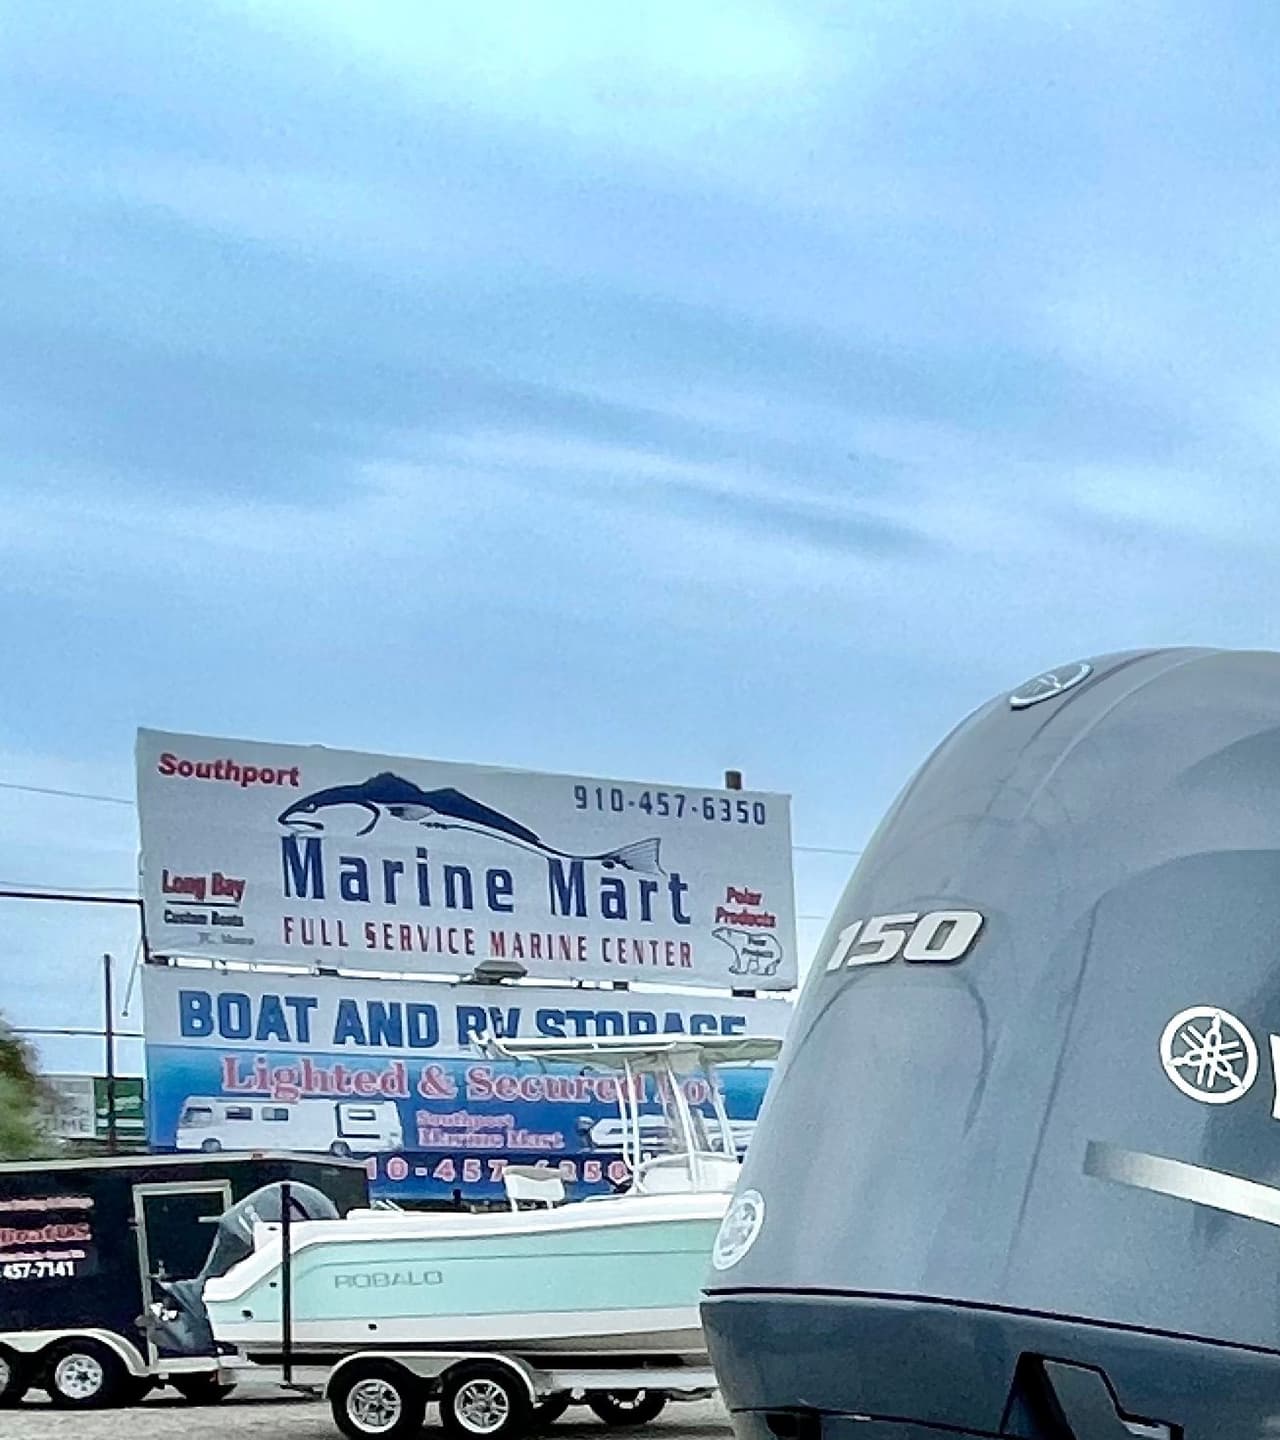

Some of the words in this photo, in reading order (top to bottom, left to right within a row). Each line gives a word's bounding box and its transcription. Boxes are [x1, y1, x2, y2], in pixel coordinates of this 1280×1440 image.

[158, 753, 300, 787] Southport
[574, 785, 766, 825] 910-457-6350
[281, 833, 514, 913] Marine
[548, 857, 691, 925] Mart
[284, 917, 349, 947] FULL
[364, 921, 475, 955] SERVICE
[489, 931, 587, 962] MARINE
[601, 937, 692, 968] CENTER
[826, 911, 983, 972] 150
[178, 990, 318, 1043] BOAT
[333, 998, 440, 1048] AND
[457, 1005, 521, 1047] RV
[222, 1055, 409, 1101] Lighted
[417, 1064, 456, 1100] &
[466, 1064, 647, 1103] Secured
[334, 1270, 443, 1289] ROBALO
